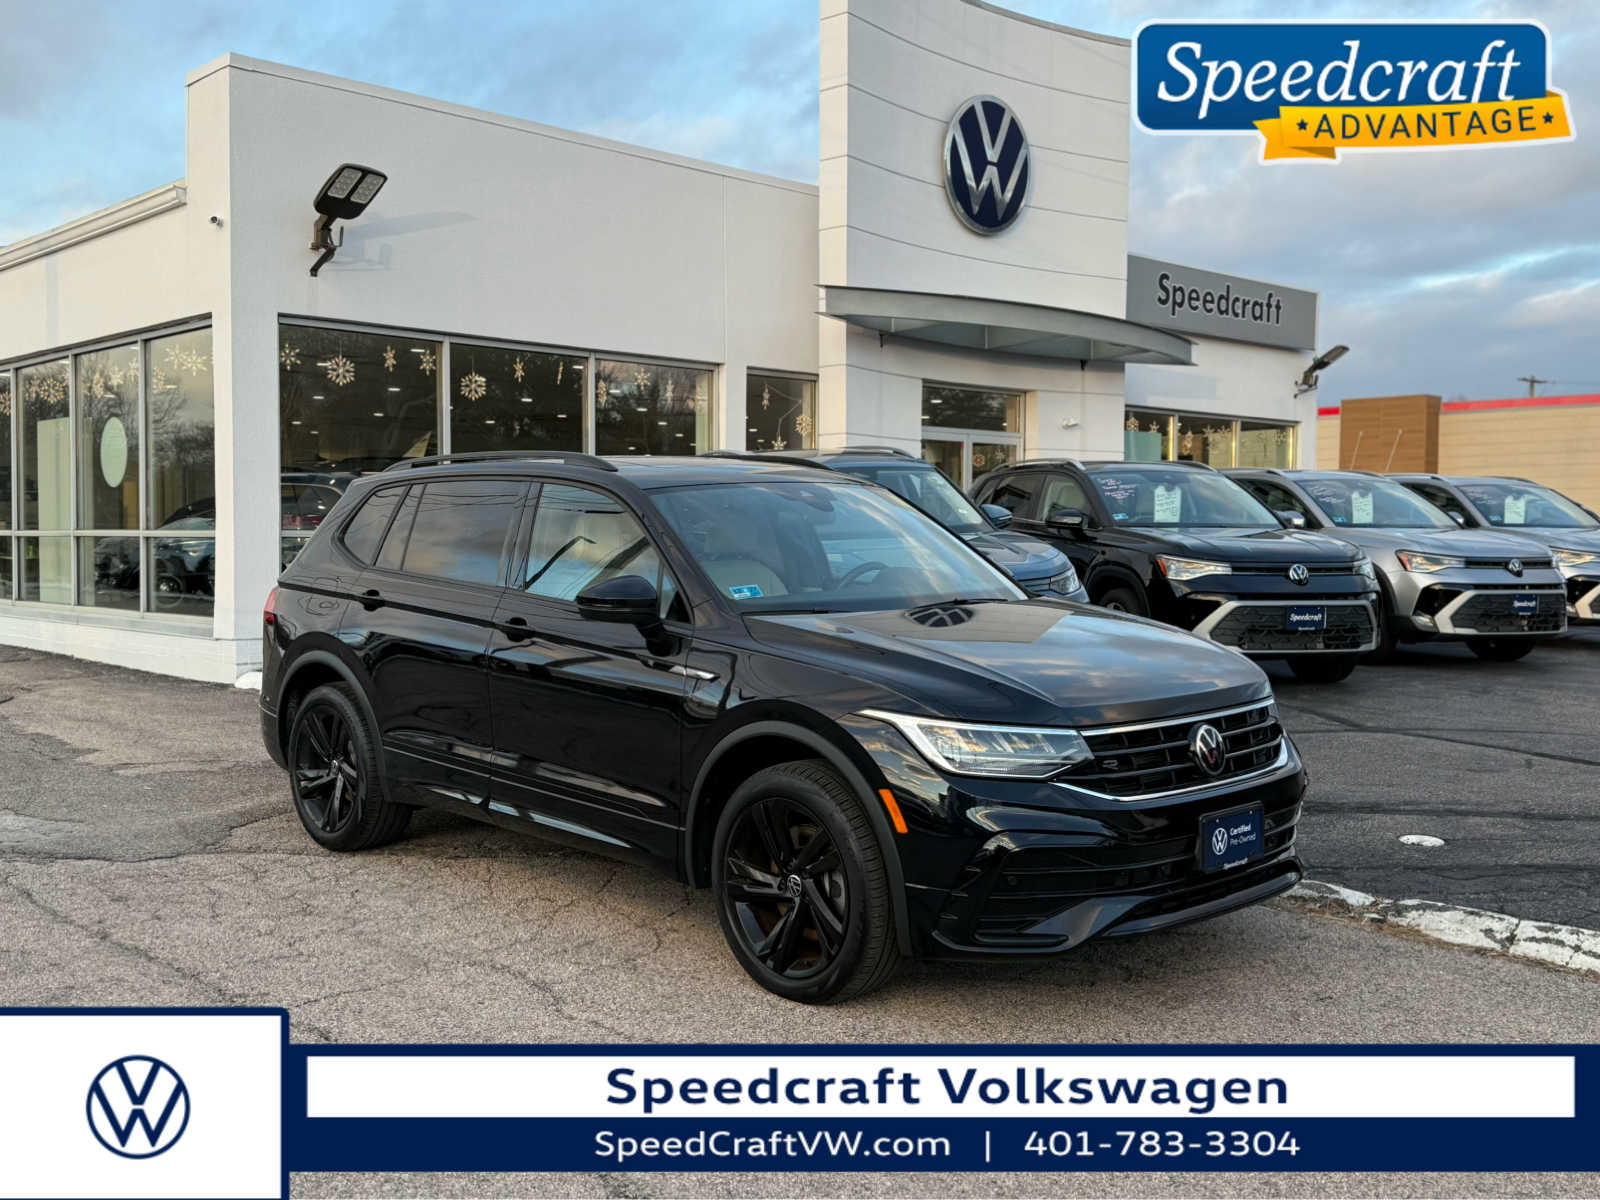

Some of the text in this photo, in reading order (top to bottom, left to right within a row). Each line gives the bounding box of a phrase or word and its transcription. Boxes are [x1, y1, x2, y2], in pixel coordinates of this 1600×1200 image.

[949, 98, 1029, 224] VW
[1157, 272, 1282, 325] Speedcraft
[1212, 828, 1227, 855] VW
